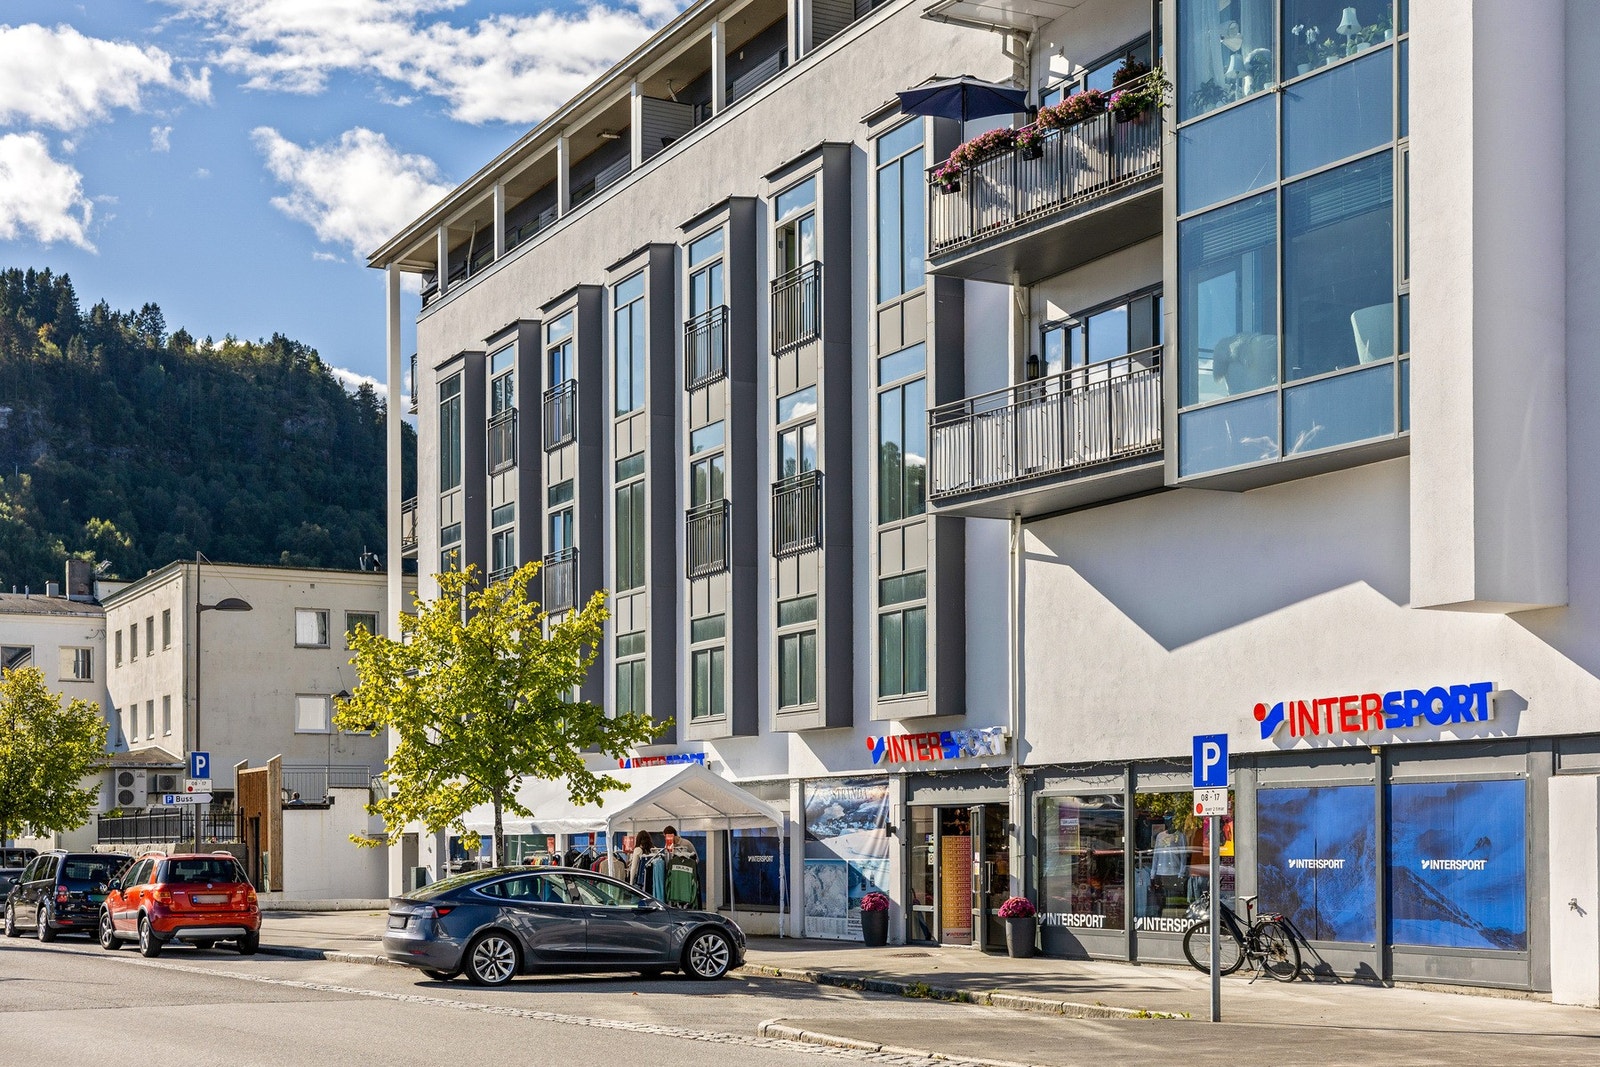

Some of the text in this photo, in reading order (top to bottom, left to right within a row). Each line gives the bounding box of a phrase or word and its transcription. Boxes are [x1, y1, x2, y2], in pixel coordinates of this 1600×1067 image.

[1289, 681, 1493, 737] INTERSPORT
[886, 726, 1005, 763] INTERSPORT
[196, 755, 206, 776] P
[1202, 741, 1221, 782] P
[1200, 793, 1209, 802] 08
[1213, 793, 1220, 801] 17
[1295, 859, 1345, 869] INTERSPORT
[1430, 859, 1487, 871] INTERSPORT
[1046, 912, 1104, 929] INTERSPORT
